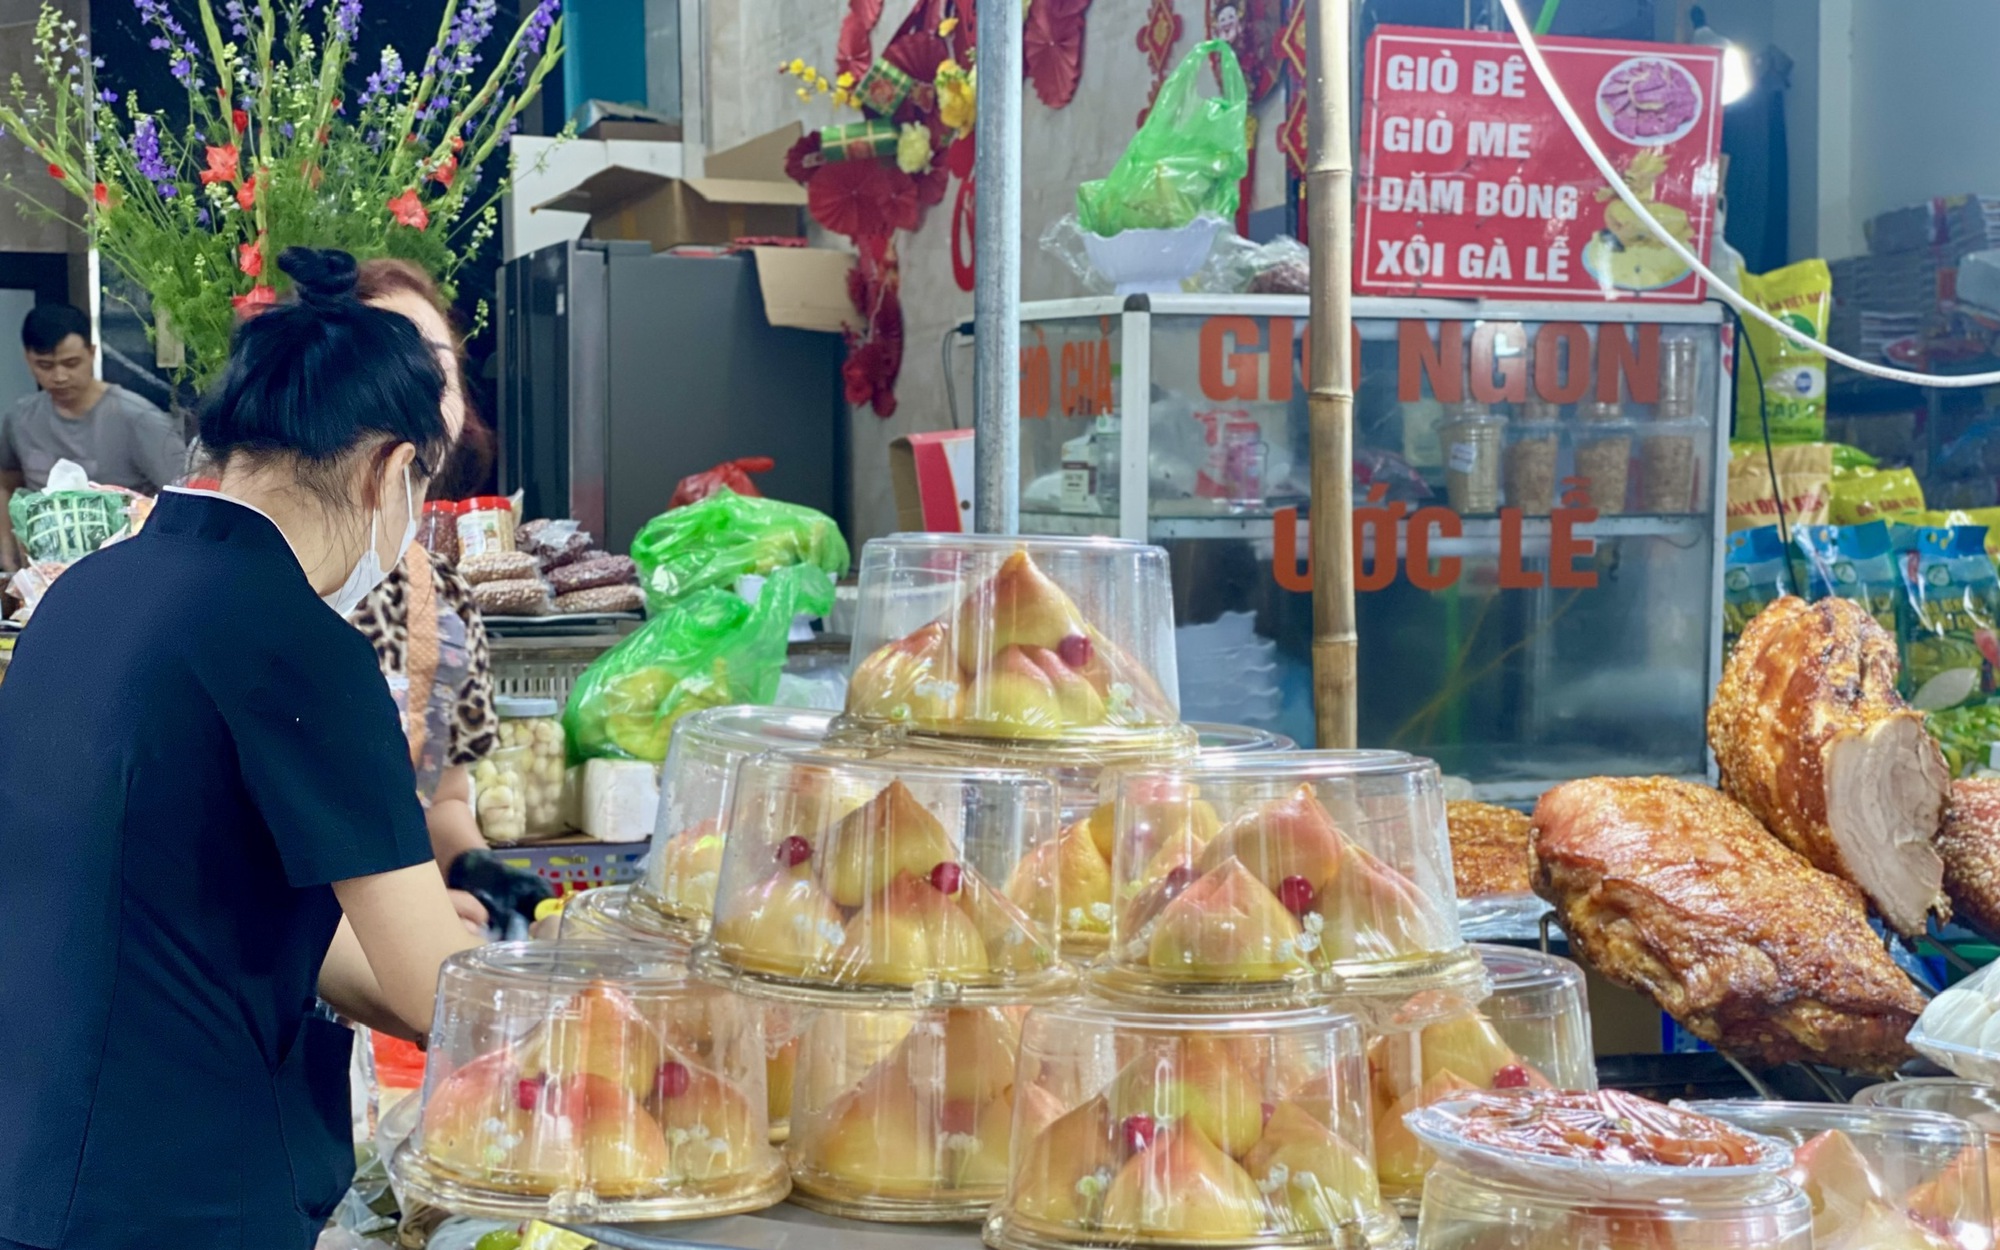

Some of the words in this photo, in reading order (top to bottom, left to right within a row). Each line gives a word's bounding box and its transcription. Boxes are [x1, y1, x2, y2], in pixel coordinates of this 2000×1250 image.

[1386, 50, 1459, 94] GIÒ
[1471, 54, 1527, 98] BÊ
[1382, 110, 1454, 155] GIÒ
[1467, 121, 1532, 158] ME
[1375, 234, 1446, 277] XÔI
[1457, 237, 1513, 280] GÀ
[1524, 235, 1571, 282] LỄ
[1198, 315, 1361, 403] GI
[1399, 320, 1662, 404] NGON
[1499, 476, 1600, 590] LỄ
